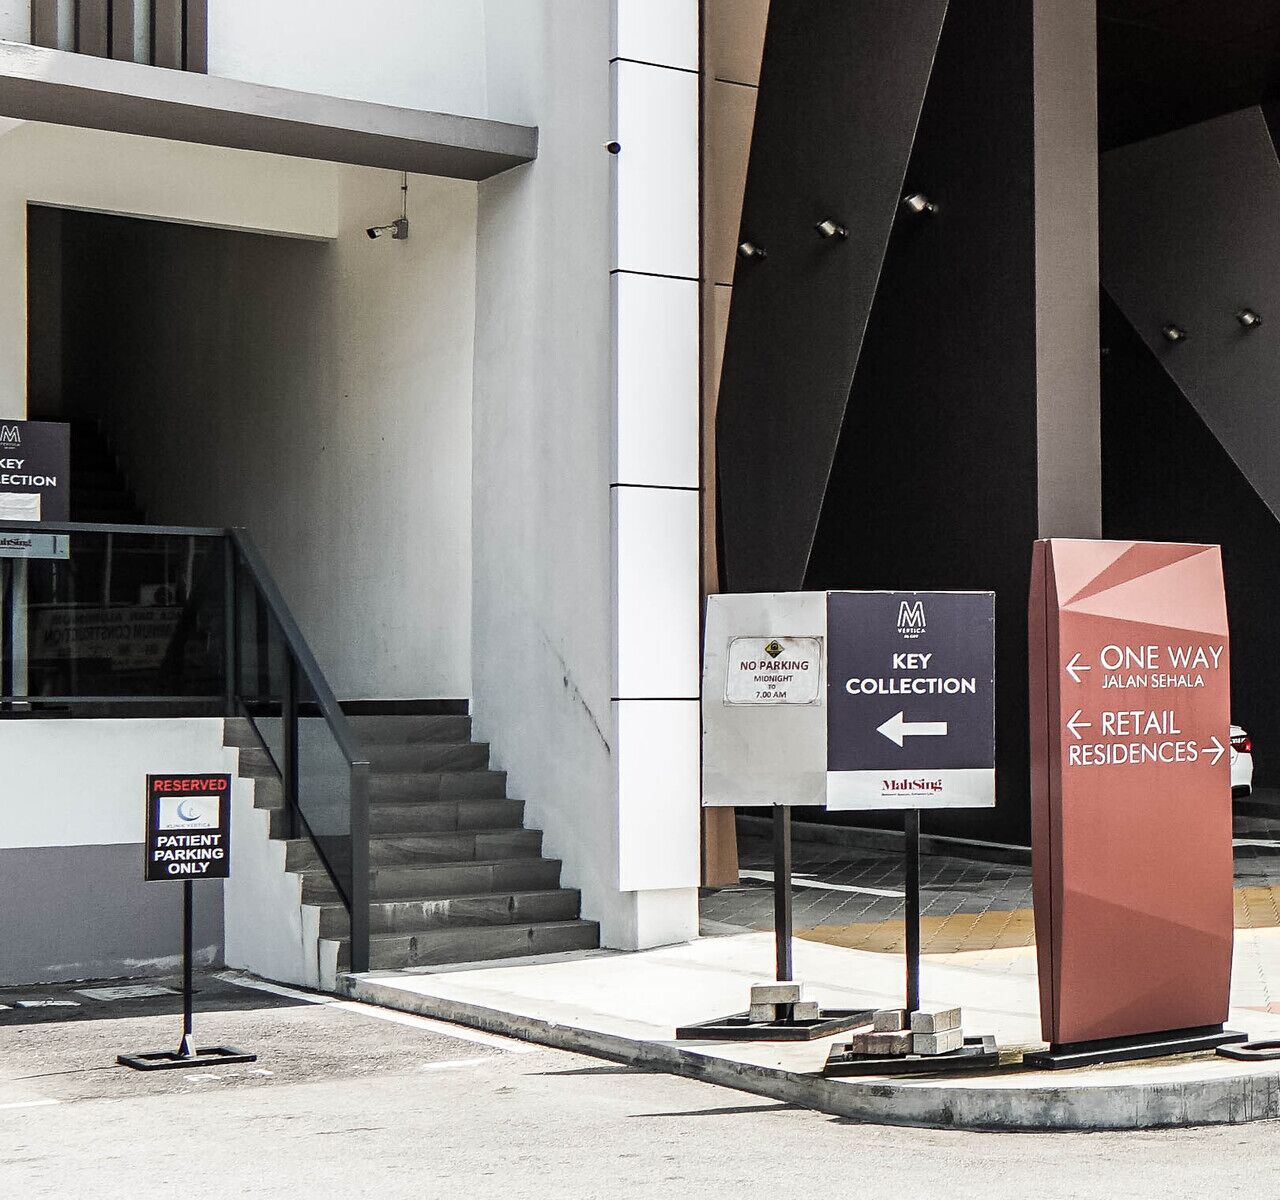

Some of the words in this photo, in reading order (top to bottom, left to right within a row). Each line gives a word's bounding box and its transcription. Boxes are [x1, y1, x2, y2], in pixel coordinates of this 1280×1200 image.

[0, 474, 57, 487] ECTION
[892, 653, 932, 669] KEY
[1100, 644, 1159, 670] ONE
[1167, 645, 1224, 669] WAY
[740, 661, 757, 670] NO
[760, 661, 809, 671] PARKING
[845, 678, 976, 694] COLLECTION
[1102, 674, 1147, 688] JALAN
[1151, 673, 1205, 688] SEHALA
[1102, 710, 1181, 736] RETAIL
[1069, 741, 1198, 766] RESIDENCES
[153, 779, 227, 791] RESERVED
[881, 778, 943, 791] MahSing
[157, 834, 221, 847] PATIENT
[154, 848, 224, 861] PARKING
[168, 862, 210, 874] ONLY
